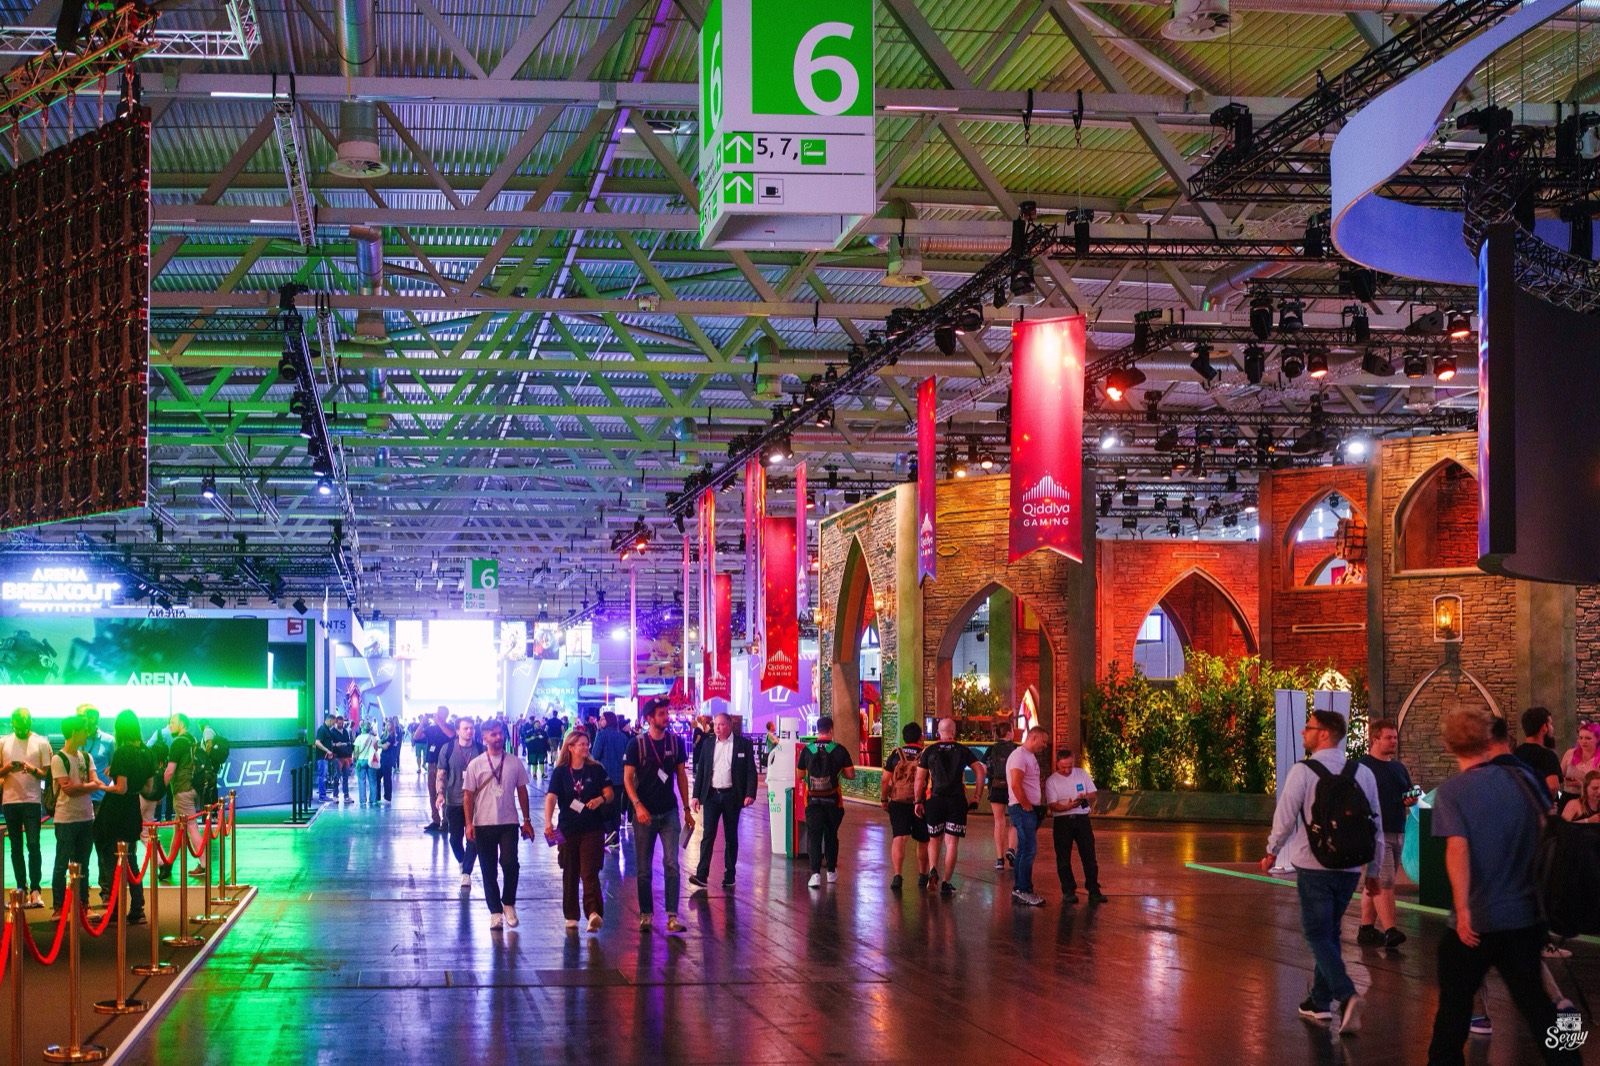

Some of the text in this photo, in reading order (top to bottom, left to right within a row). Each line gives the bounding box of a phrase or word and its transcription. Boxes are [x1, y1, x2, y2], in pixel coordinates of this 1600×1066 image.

[793, 21, 859, 116] 6
[710, 30, 722, 130] 6
[1022, 503, 1070, 517] Qiddiya
[1023, 517, 1069, 527] GAMING
[31, 567, 89, 582] ARENA
[481, 568, 496, 589] 6
[2, 581, 121, 600] BREAKOUT
[127, 671, 193, 686] ARENA
